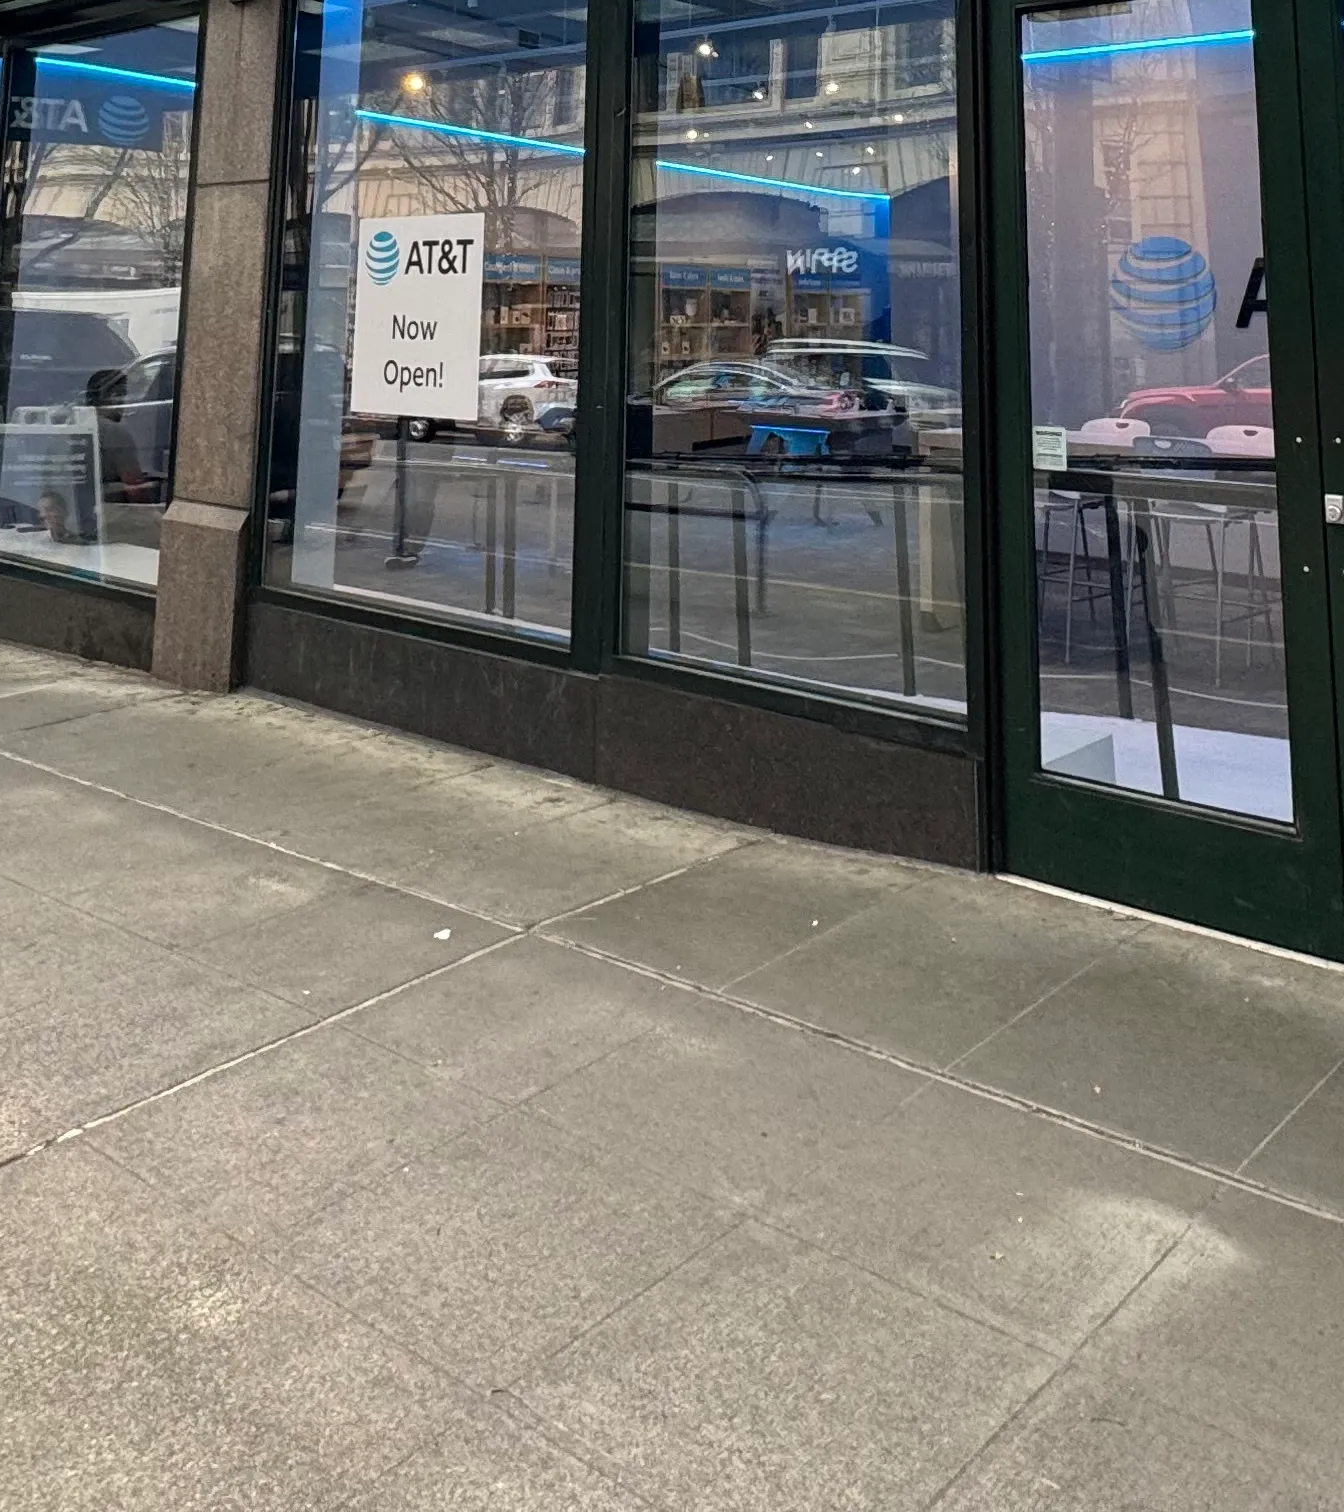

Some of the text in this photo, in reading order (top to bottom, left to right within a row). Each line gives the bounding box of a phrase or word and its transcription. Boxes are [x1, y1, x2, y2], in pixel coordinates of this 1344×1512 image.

[404, 239, 474, 275] AT&T
[392, 315, 437, 340] Now
[383, 359, 444, 393] Open!
